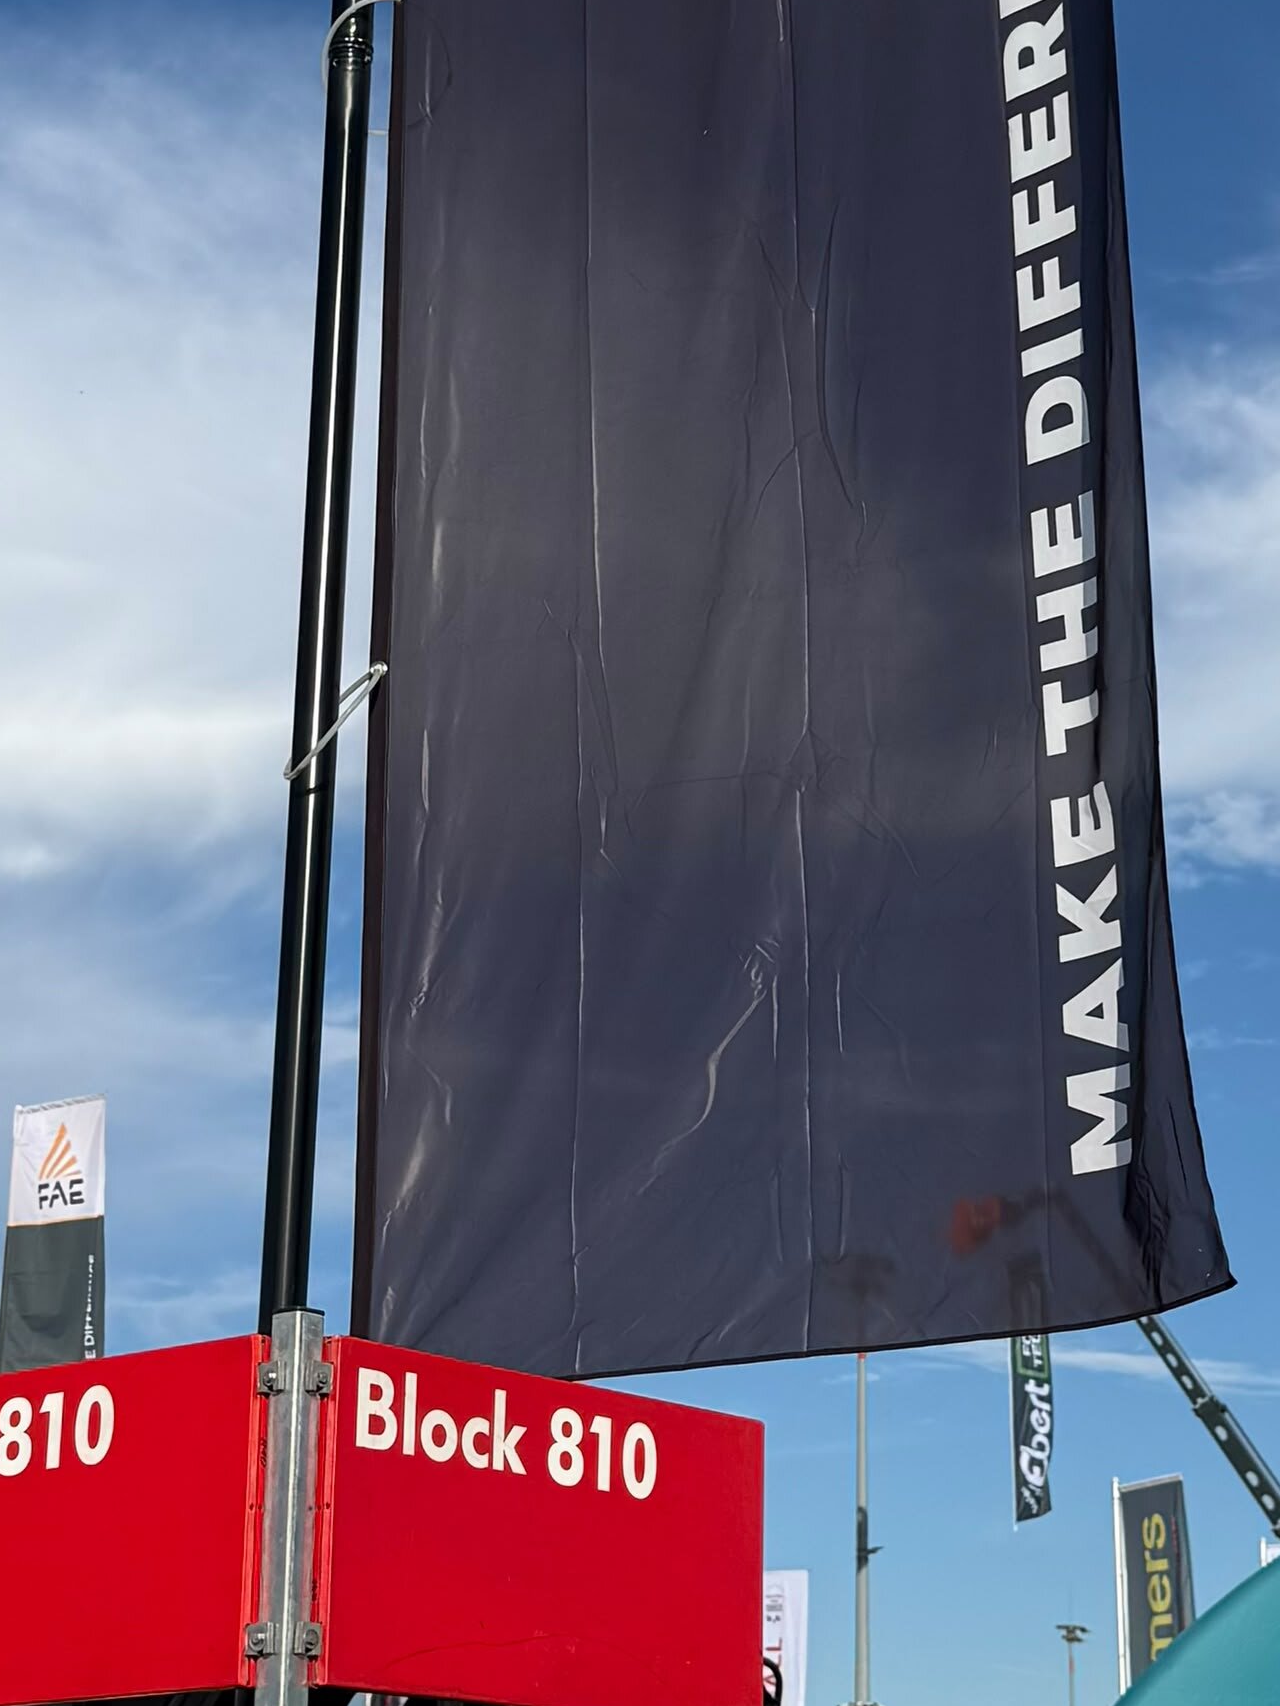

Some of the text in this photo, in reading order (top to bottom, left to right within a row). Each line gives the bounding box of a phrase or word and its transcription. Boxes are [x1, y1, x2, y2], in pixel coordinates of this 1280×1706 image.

[1030, 489, 1099, 757] THE
[1050, 781, 1133, 1176] MAKE
[38, 1178, 85, 1210] FAE
[355, 1366, 658, 1500] Block 810
[1020, 1378, 1052, 1488] Ebert
